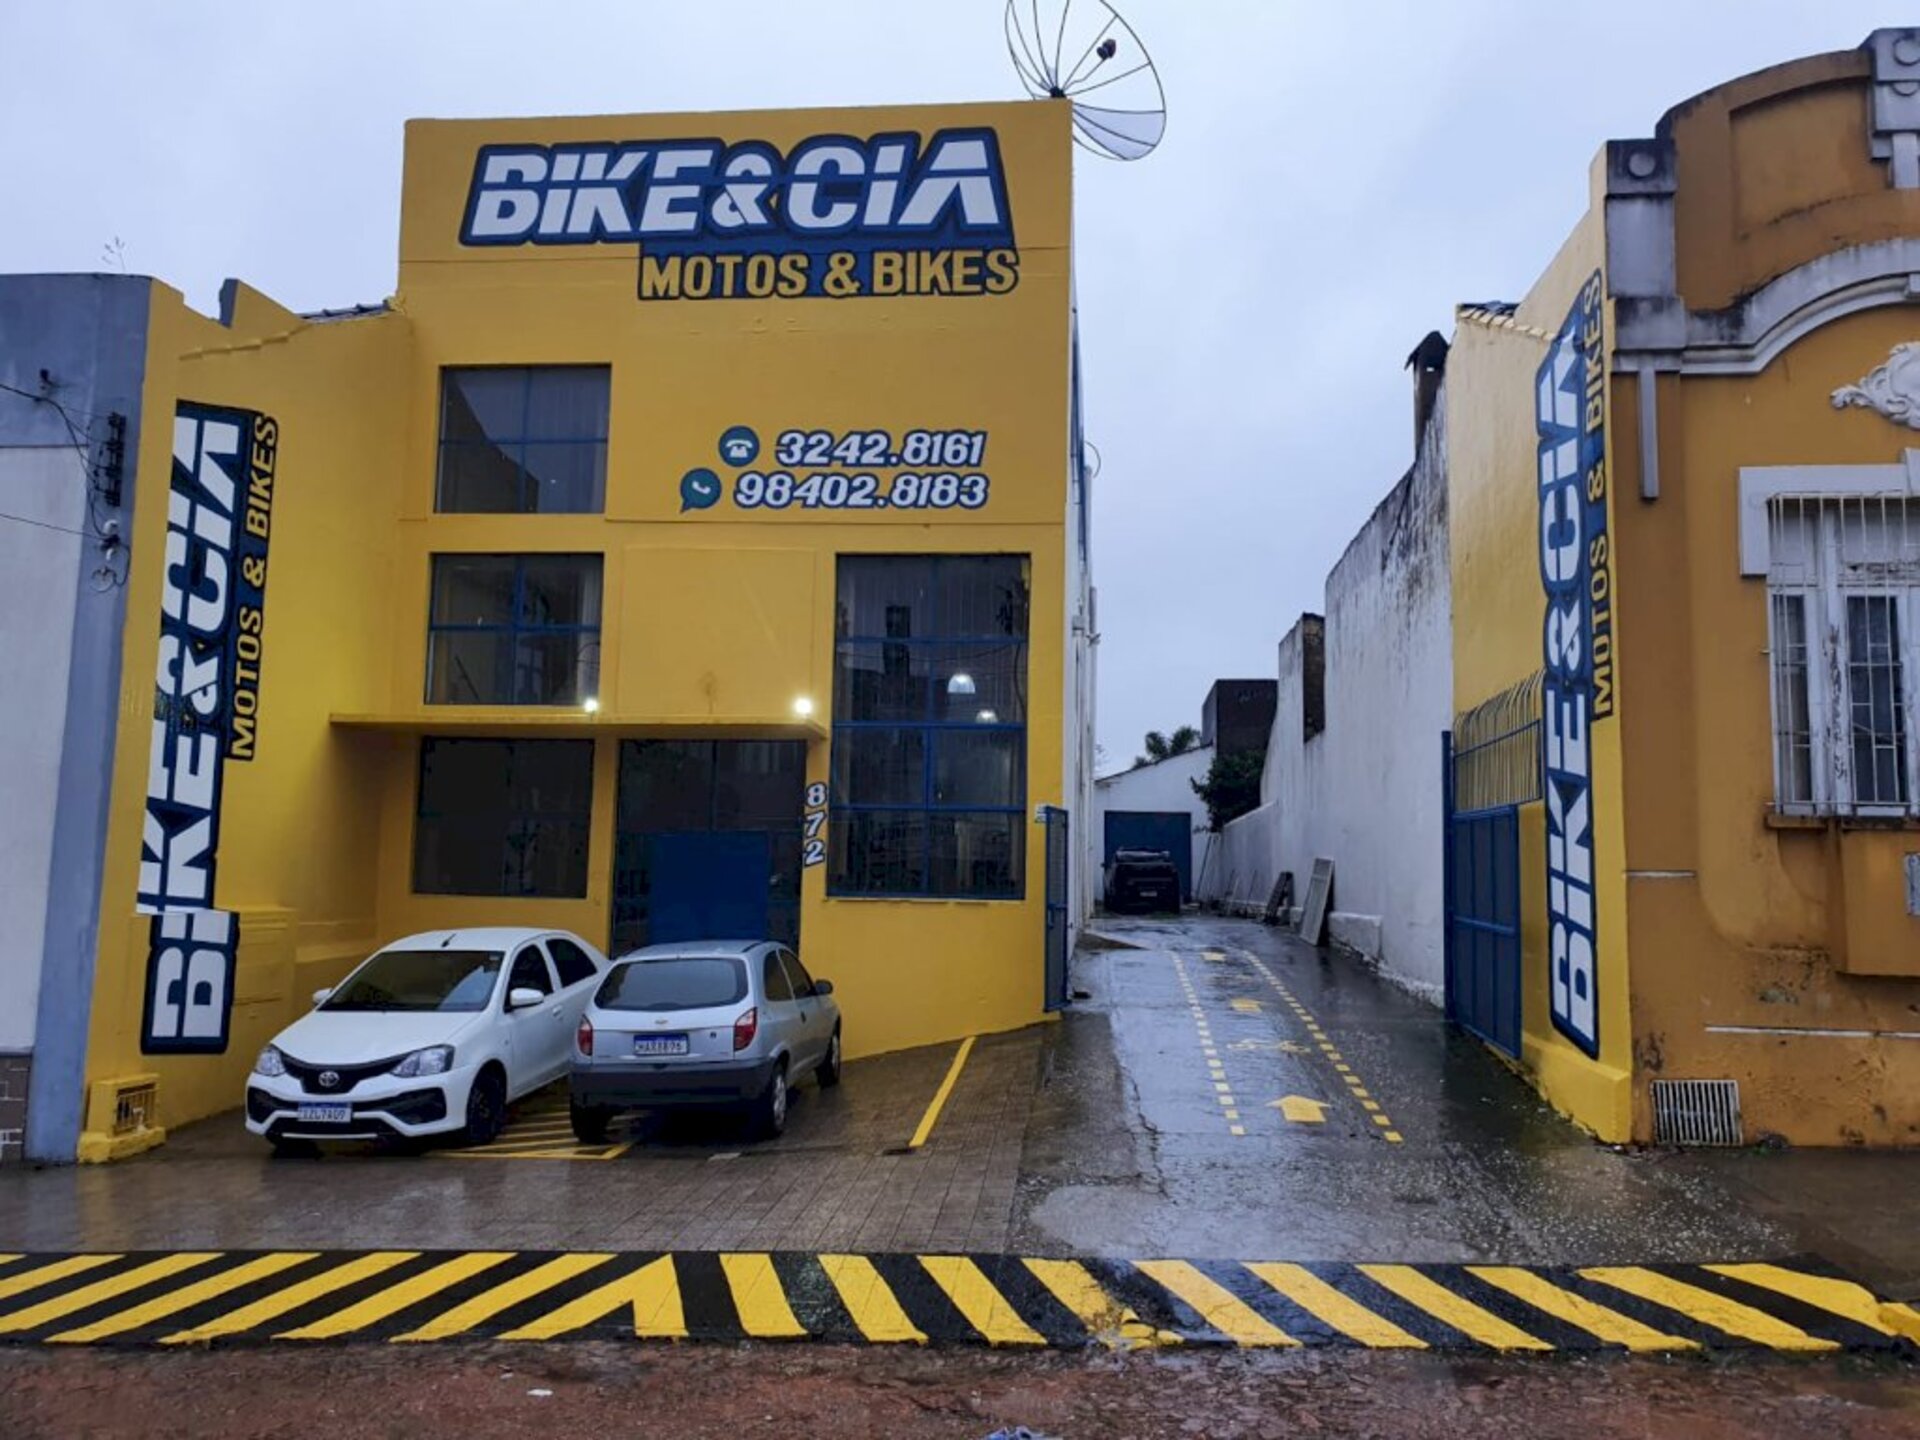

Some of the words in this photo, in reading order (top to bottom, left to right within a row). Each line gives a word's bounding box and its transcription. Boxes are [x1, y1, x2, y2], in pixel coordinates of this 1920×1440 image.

[469, 138, 1000, 237] BIKE&CIA
[642, 253, 806, 298] MOTOS
[823, 252, 860, 295] &
[873, 248, 1018, 294] BIKES
[1584, 273, 1603, 435] BIKES
[245, 414, 277, 538] BIKES
[777, 431, 985, 465] 3242.8161
[1587, 458, 1604, 503] &
[736, 472, 988, 507] 98402.8183
[243, 557, 266, 588] &
[1590, 533, 1612, 716] MOTOS
[231, 606, 263, 760] MOTOS
[806, 783, 826, 865] 872
